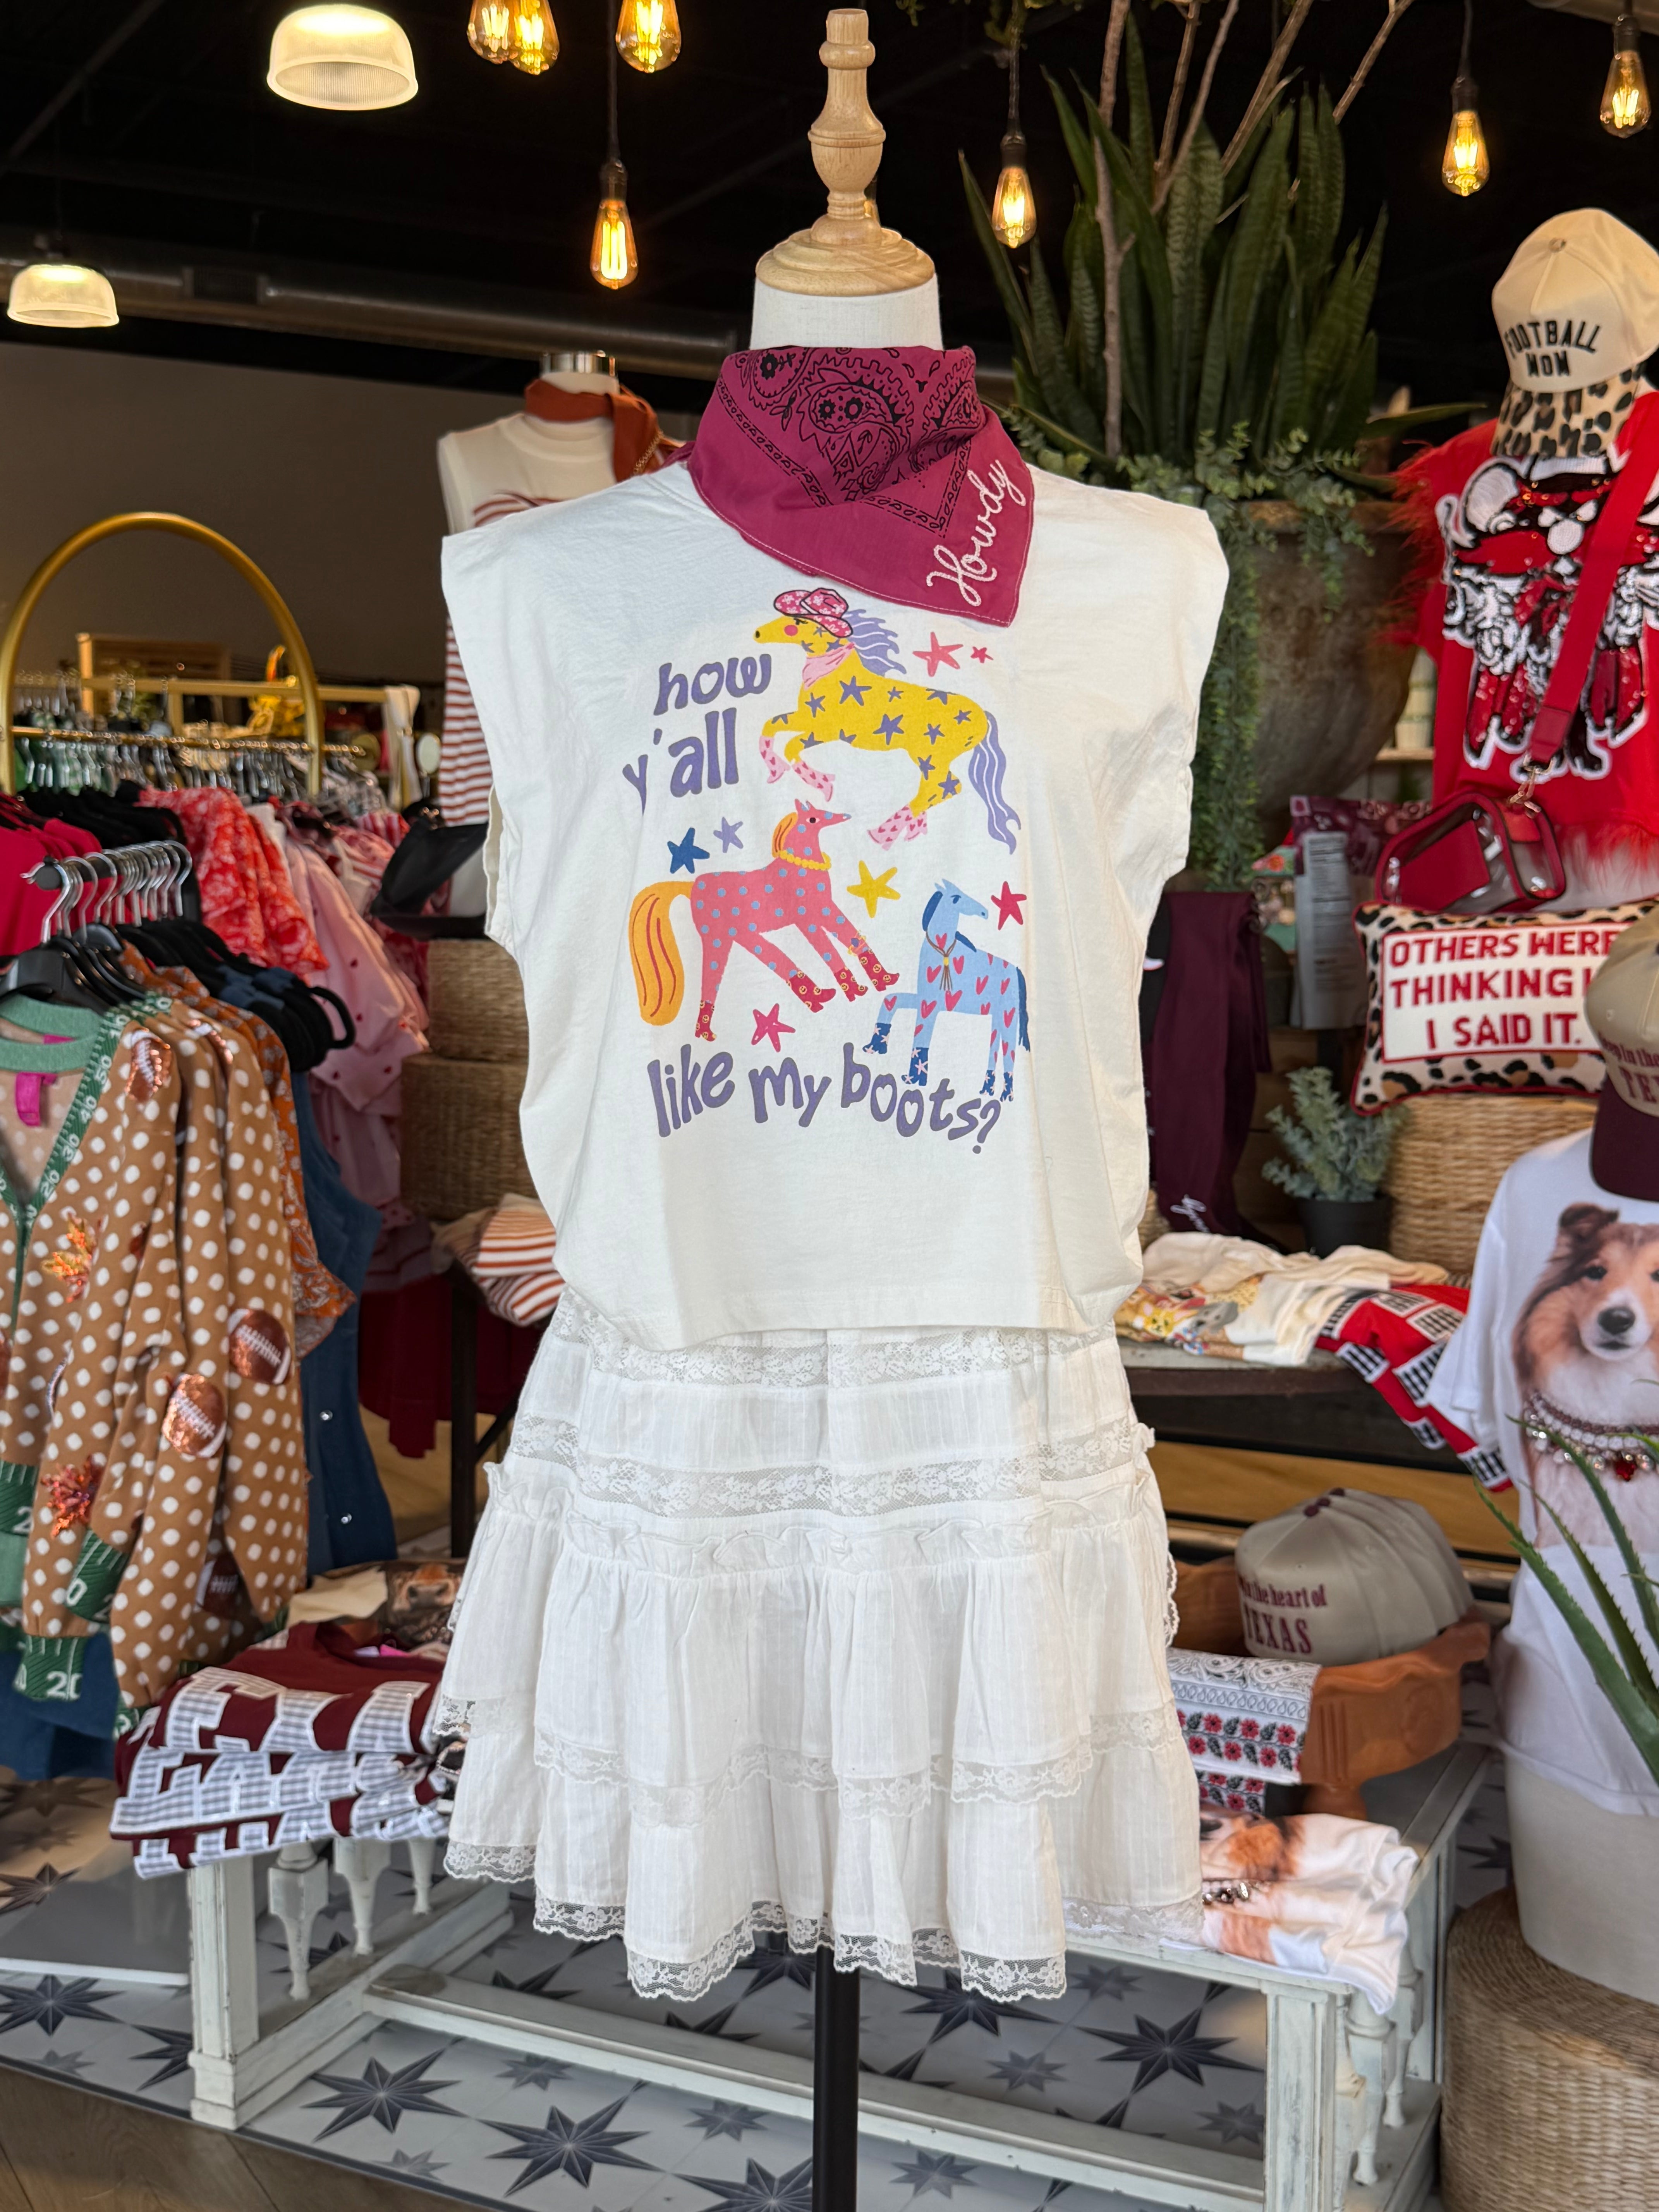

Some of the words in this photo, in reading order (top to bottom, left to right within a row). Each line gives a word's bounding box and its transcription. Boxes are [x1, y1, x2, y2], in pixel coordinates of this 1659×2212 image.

[1504, 318, 1601, 359] FOOTBALL
[1525, 350, 1570, 377] MOM
[926, 459, 1026, 607] Howdy
[653, 653, 771, 716] how
[622, 708, 740, 816] y'all
[1389, 933, 1519, 967] OTHERS
[1389, 968, 1573, 1008] THINKING
[1426, 1018, 1436, 1050] I
[1453, 1012, 1532, 1046] SAID
[1543, 1012, 1581, 1044] IT.
[94, 1054, 112, 1085] 50
[81, 1095, 97, 1123] 40
[647, 1044, 737, 1138] like
[749, 1057, 832, 1128] my
[841, 1042, 1002, 1155] boots?
[62, 1133, 80, 1161] 30
[40, 1170, 60, 1199] 20
[1268, 1583, 1310, 1607] heart
[1243, 1601, 1312, 1655] TEXAS
